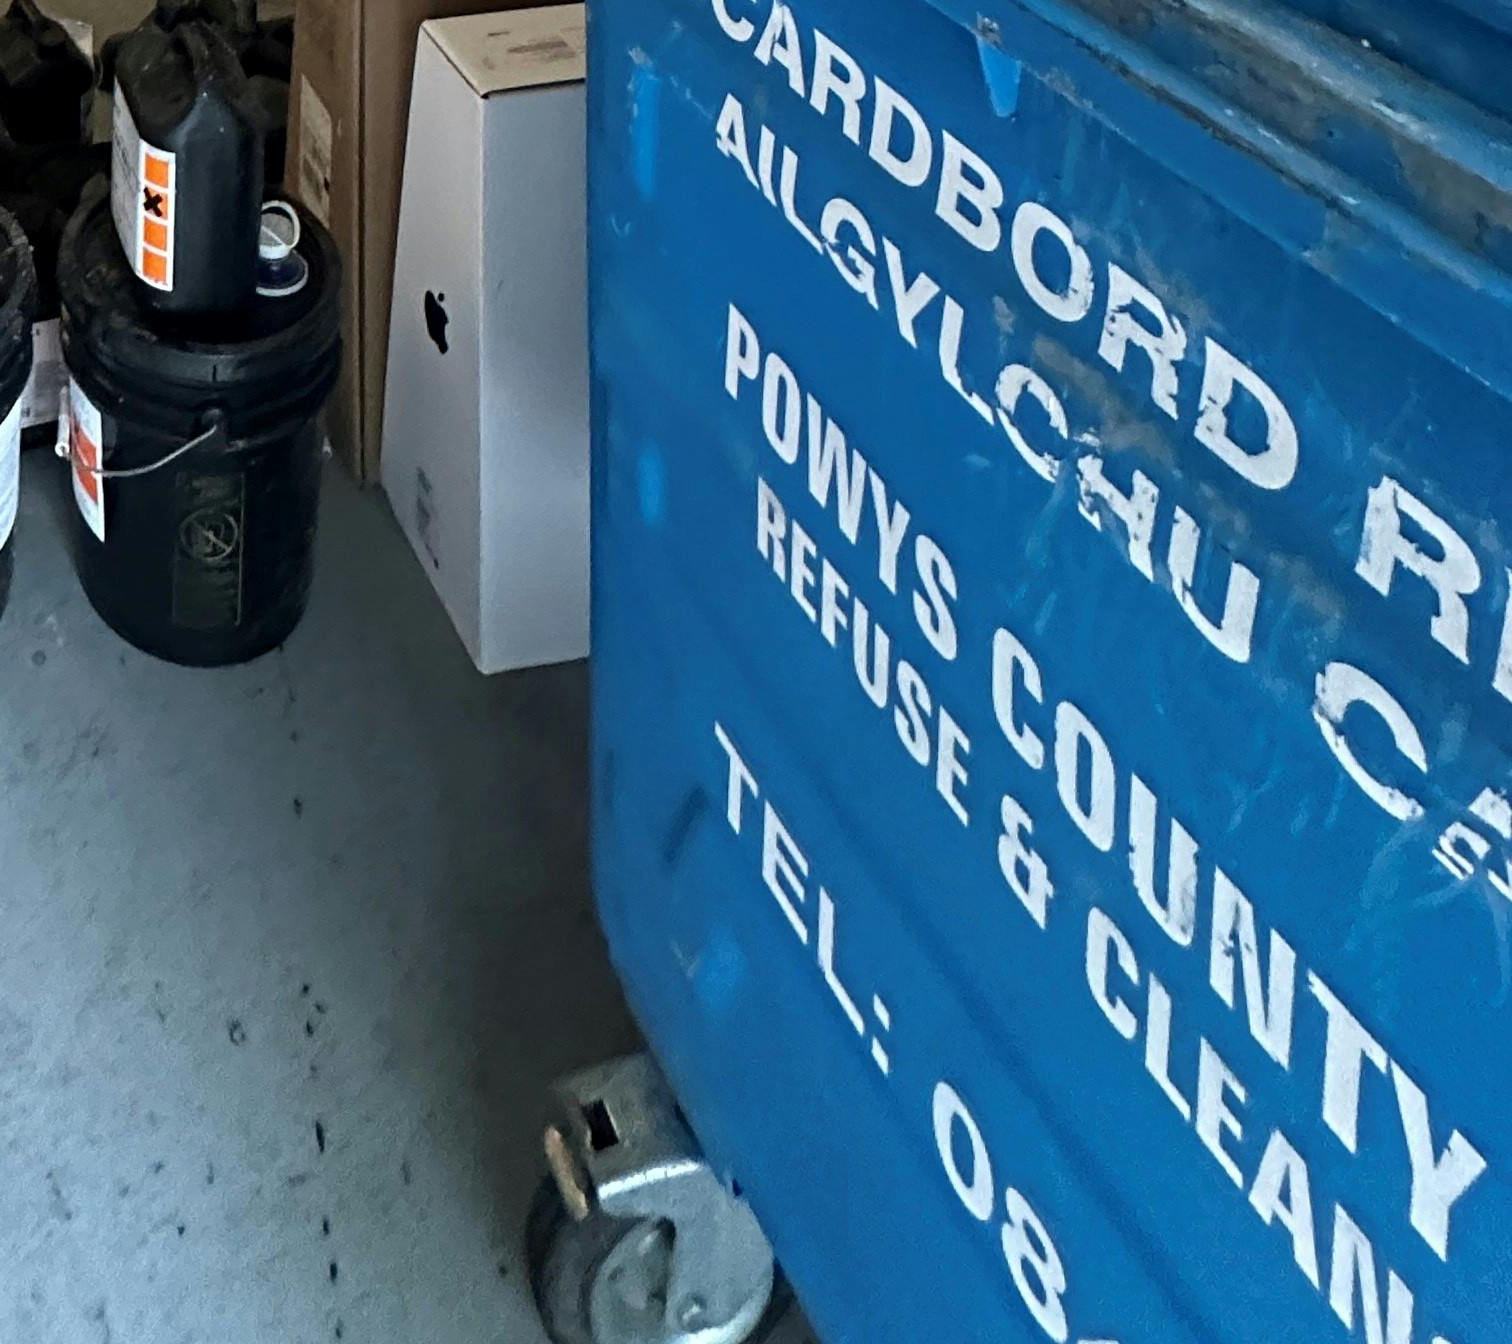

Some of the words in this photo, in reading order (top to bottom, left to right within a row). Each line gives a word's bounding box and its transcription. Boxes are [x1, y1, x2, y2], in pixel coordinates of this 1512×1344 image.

[716, 93, 1260, 662] AILGYLCHU
[1313, 662, 1512, 900] C
[725, 303, 957, 661] POWYS
[992, 627, 1488, 1263] COUNTY
[1355, 475, 1512, 704] R
[715, 721, 889, 1075] TEL:
[932, 1081, 1121, 1344] 08
[757, 475, 970, 827] REFUSE
[998, 795, 1054, 929] &
[1088, 908, 1458, 1344] CLEAN
